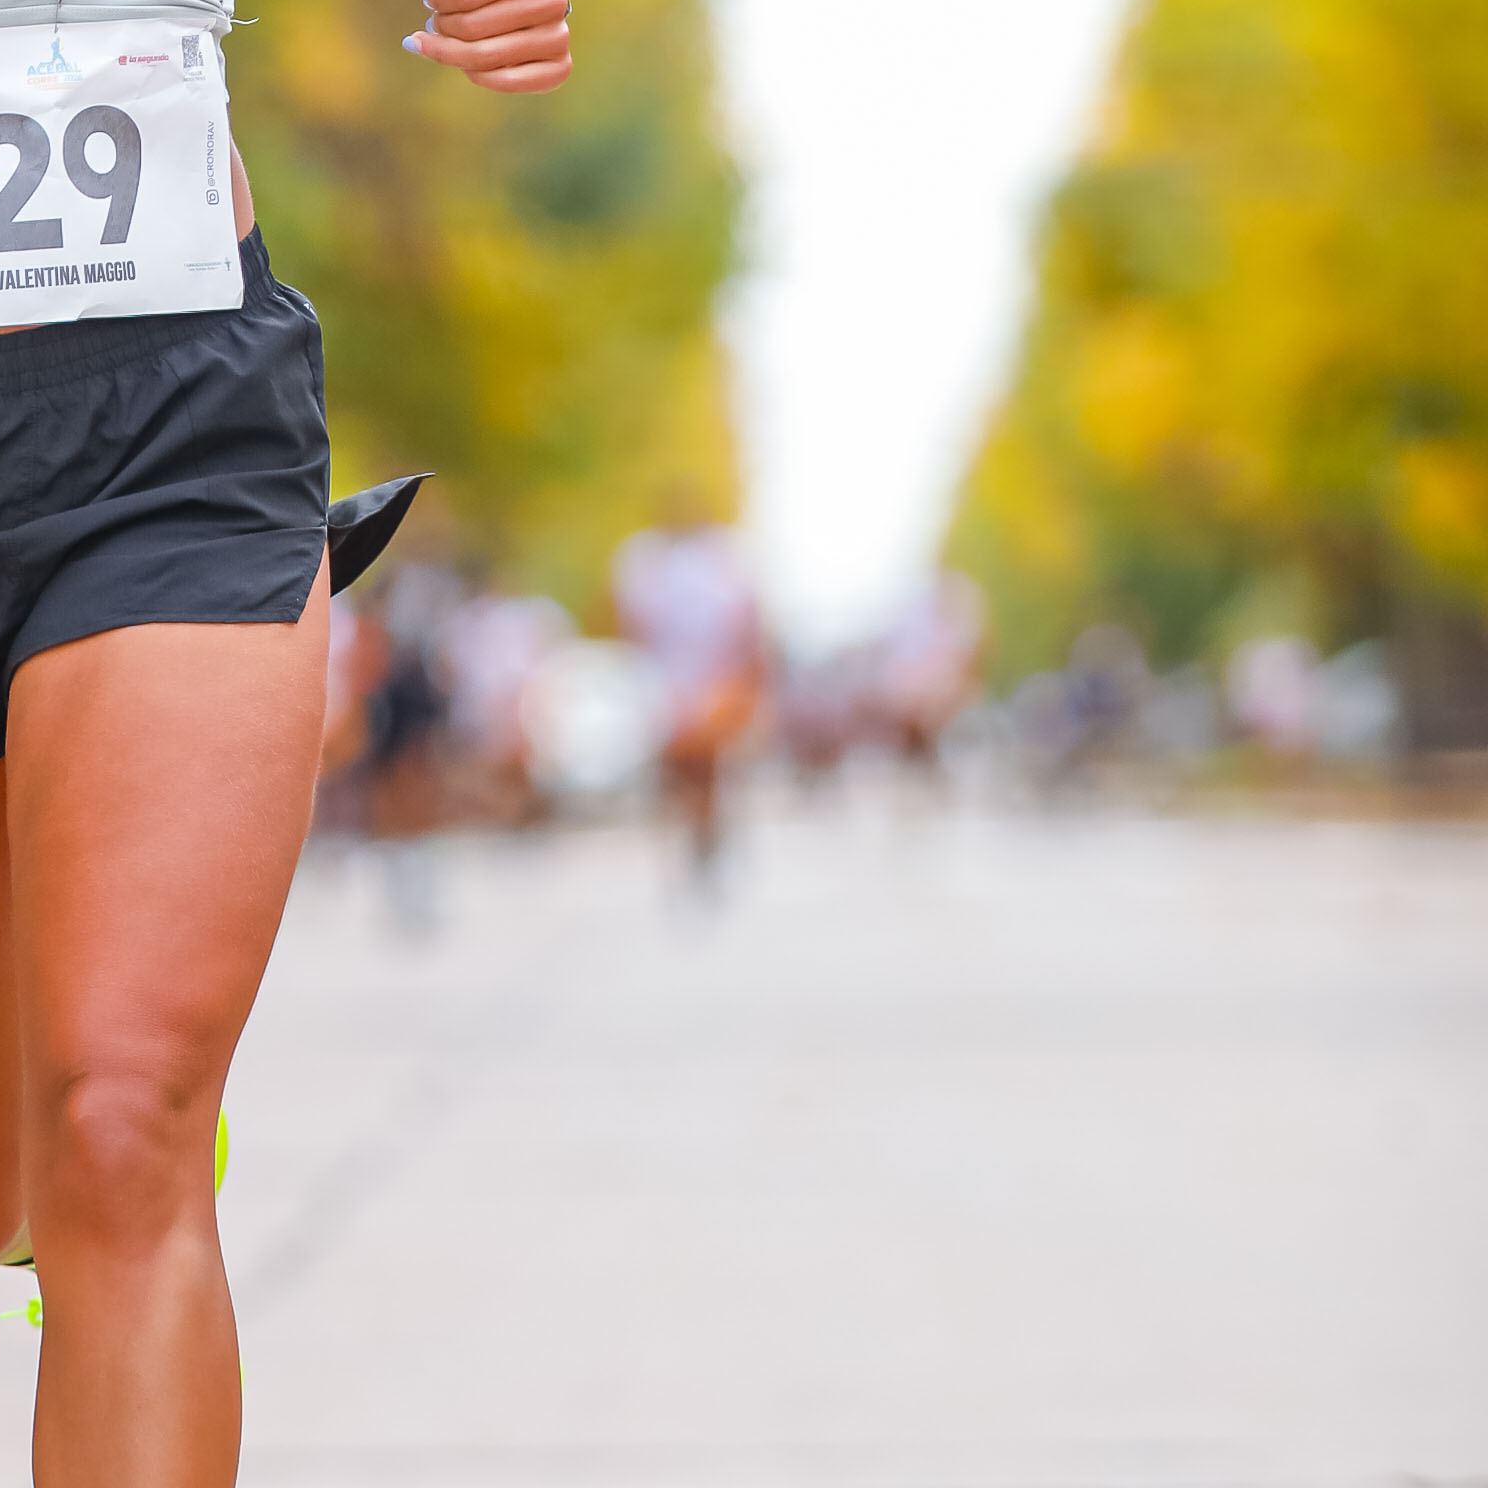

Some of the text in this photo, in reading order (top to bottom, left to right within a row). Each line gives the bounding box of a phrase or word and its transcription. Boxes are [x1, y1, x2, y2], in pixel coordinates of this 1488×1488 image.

[129, 55, 137, 63] la
[206, 120, 215, 187] @CRONORAV
[83, 260, 136, 284] MAGGIO
